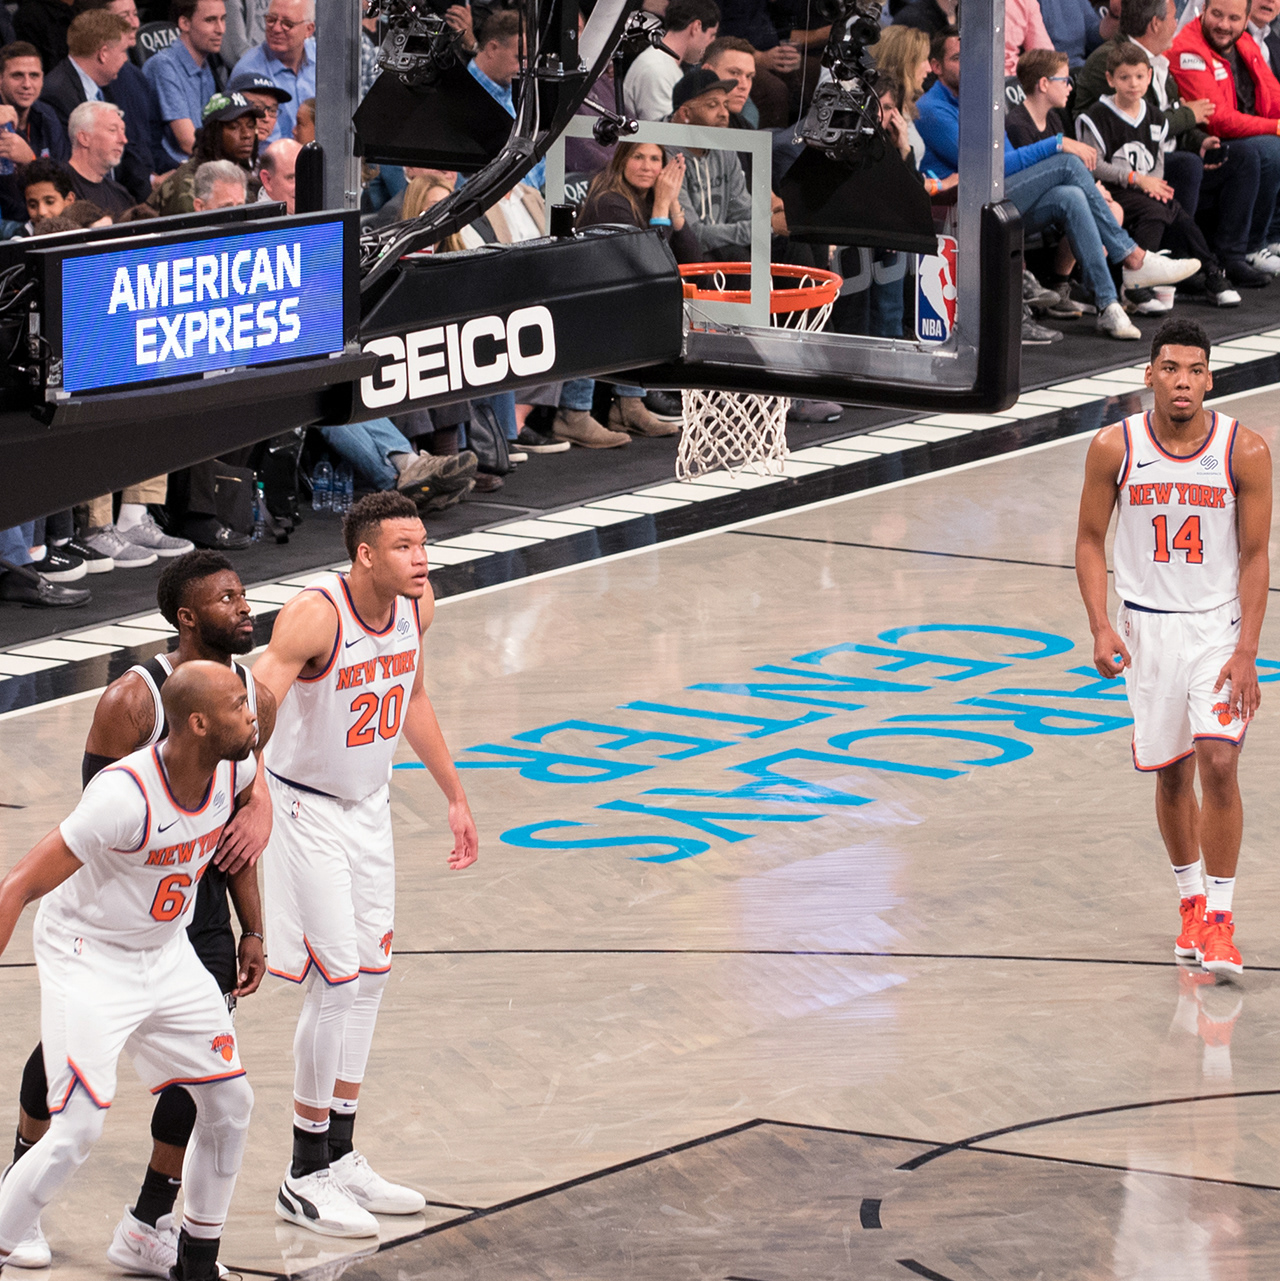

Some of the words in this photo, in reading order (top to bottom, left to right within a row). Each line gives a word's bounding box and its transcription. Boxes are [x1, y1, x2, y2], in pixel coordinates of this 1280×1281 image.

[108, 242, 302, 315] AMERICAN
[135, 296, 302, 366] EXPRESS
[921, 318, 943, 338] NBA
[360, 305, 556, 410] GEICO
[1128, 482, 1174, 507] NEW
[1175, 481, 1227, 509] YORK
[1151, 514, 1204, 565] 14
[335, 655, 378, 692] NEW
[378, 648, 418, 680] YORK
[346, 683, 405, 748] 20
[144, 837, 197, 867] NEW
